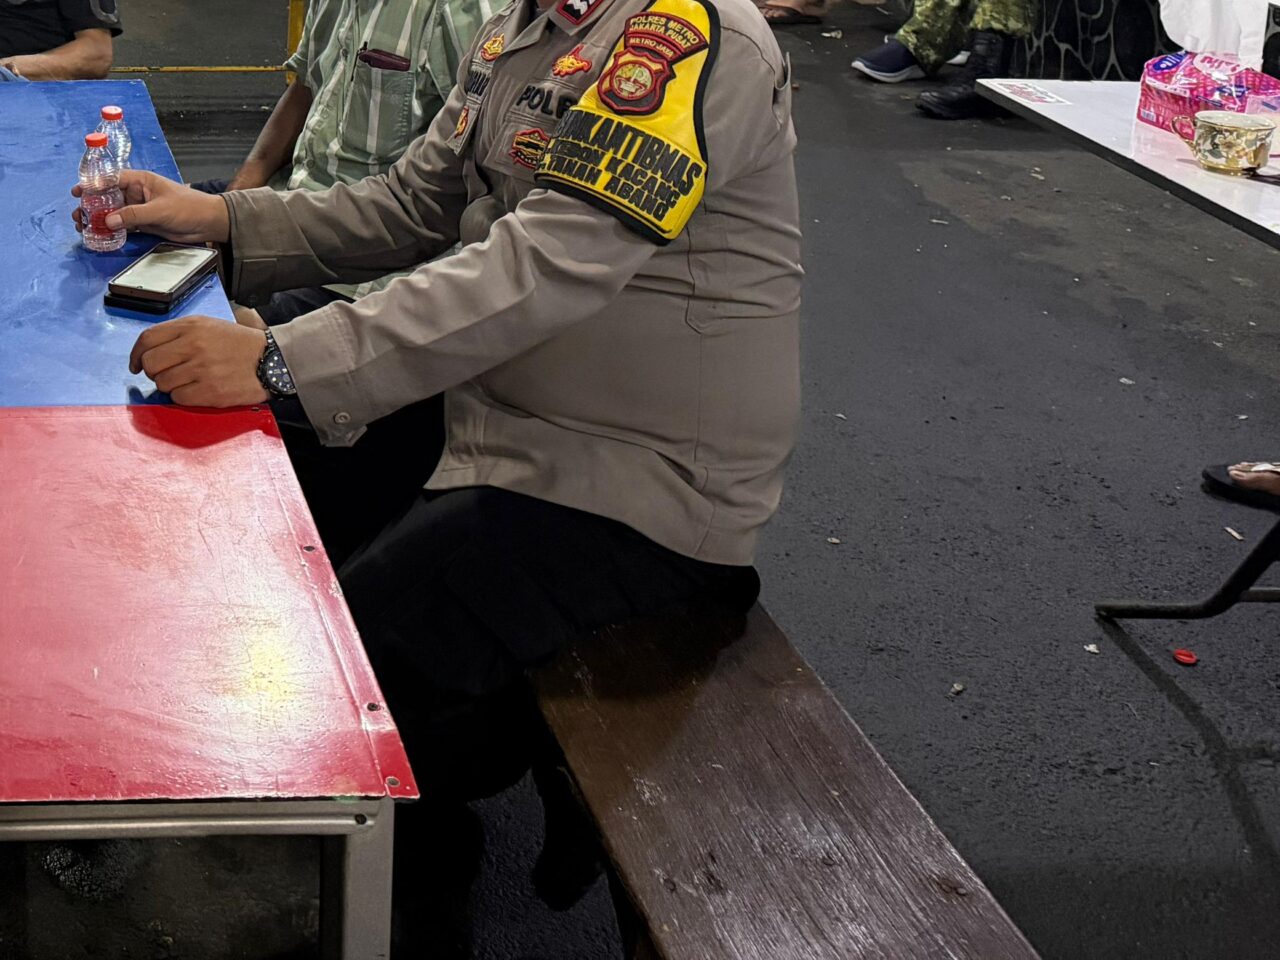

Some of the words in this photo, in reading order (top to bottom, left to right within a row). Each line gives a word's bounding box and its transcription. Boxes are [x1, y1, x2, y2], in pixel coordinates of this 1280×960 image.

[629, 22, 665, 34] JAKARTA
[665, 29, 691, 48] PUSAT
[630, 16, 667, 25] POLRES
[667, 20, 699, 44] METRO
[629, 37, 656, 46] METRO
[656, 44, 674, 57] JAYA
[516, 85, 578, 120] POLR
[605, 154, 681, 209] KACANG
[604, 174, 670, 222] ABANG
